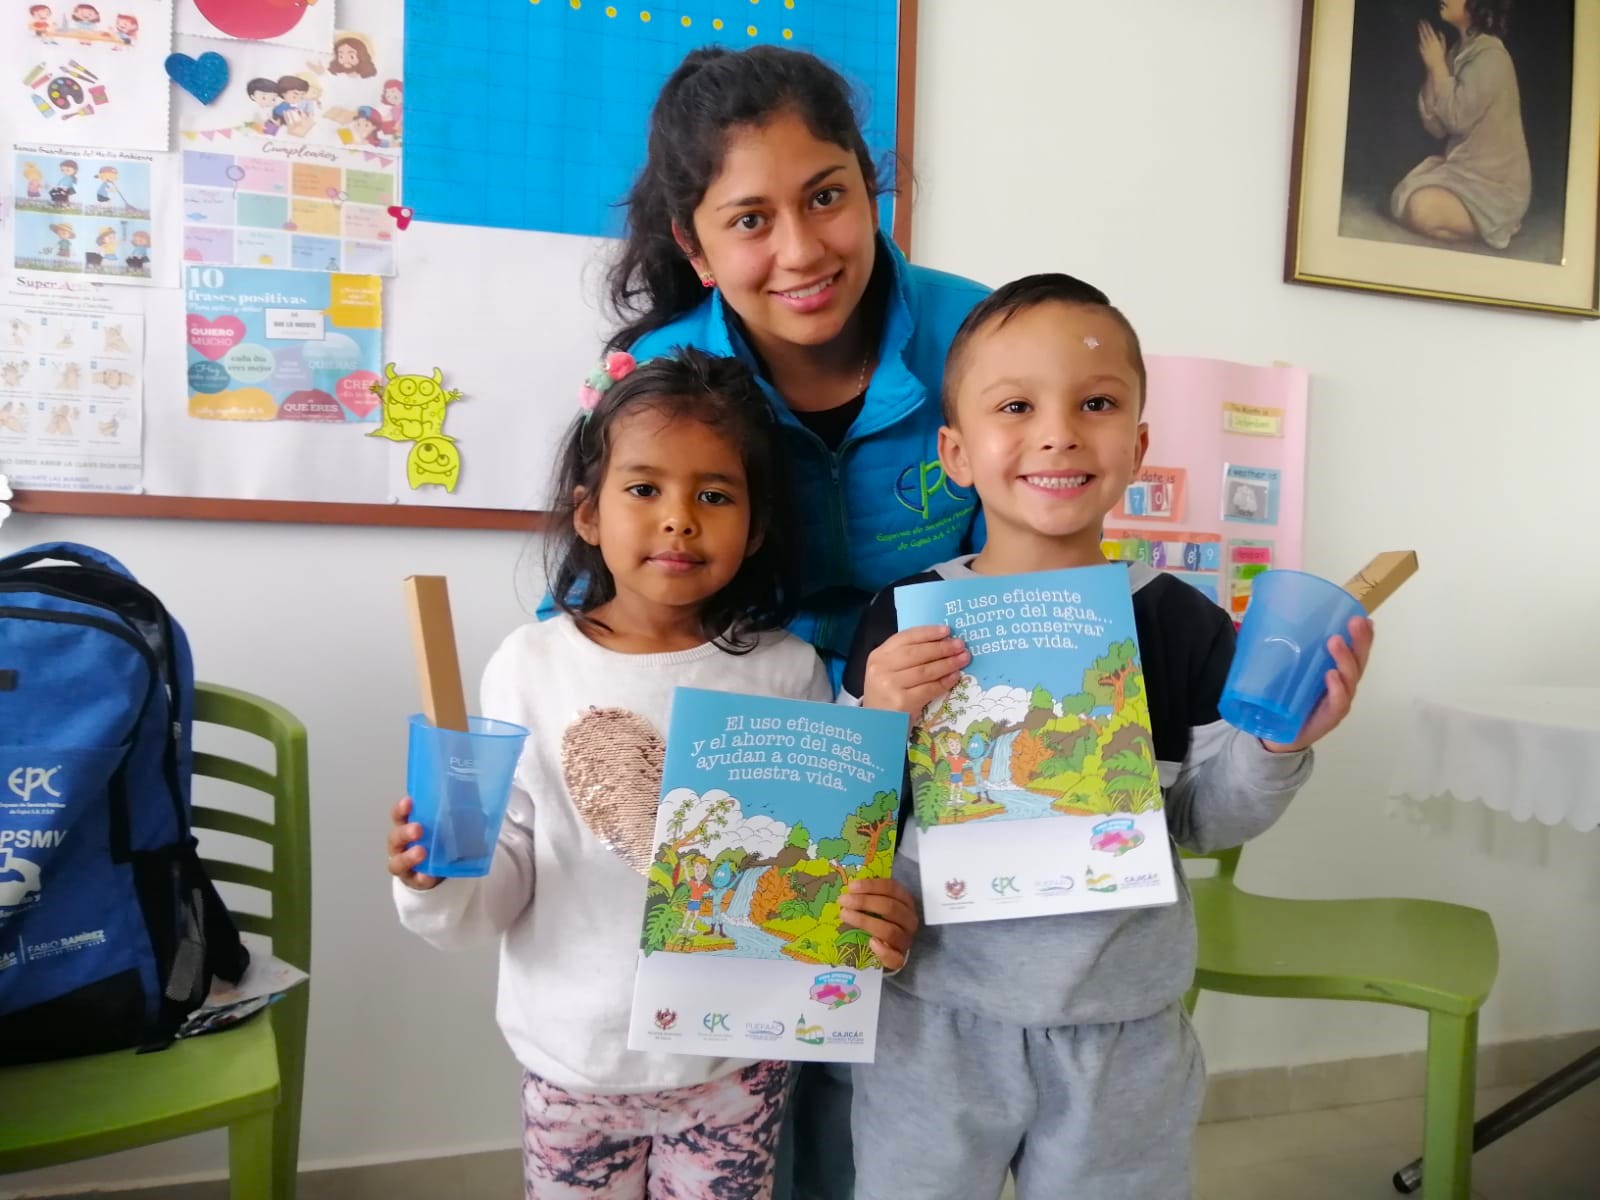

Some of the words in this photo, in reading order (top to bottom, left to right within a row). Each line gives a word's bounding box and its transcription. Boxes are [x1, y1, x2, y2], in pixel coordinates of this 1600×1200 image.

[16, 276, 57, 290] Super
[189, 267, 224, 289] 10
[188, 290, 237, 303] frases
[239, 292, 307, 306] positivas
[190, 327, 235, 338] QUIERO
[283, 403, 309, 414] QUE
[1141, 470, 1164, 483] date
[1166, 474, 1176, 485] is
[944, 600, 963, 616] El
[967, 595, 998, 610] uso
[1003, 588, 1081, 604] eficiente
[955, 607, 1015, 629] ahorro
[1020, 603, 1047, 618] del
[1052, 606, 1113, 625] agua...
[995, 624, 1007, 636] a
[1011, 620, 1105, 638] conservar
[967, 636, 1029, 656] uestra
[1032, 635, 1078, 650] vida.
[725, 716, 744, 731] El
[750, 717, 781, 730] uso
[786, 717, 863, 745] eficiente
[690, 739, 706, 757] y
[710, 734, 726, 749] el
[731, 732, 795, 747] ahorro
[800, 734, 827, 752] del
[831, 743, 885, 772] agua...
[696, 750, 766, 771] ayudan
[771, 751, 783, 763] a
[787, 752, 876, 784] conservar
[727, 766, 801, 782] nuestra
[806, 771, 848, 792] vida.
[703, 1012, 731, 1033] EPC
